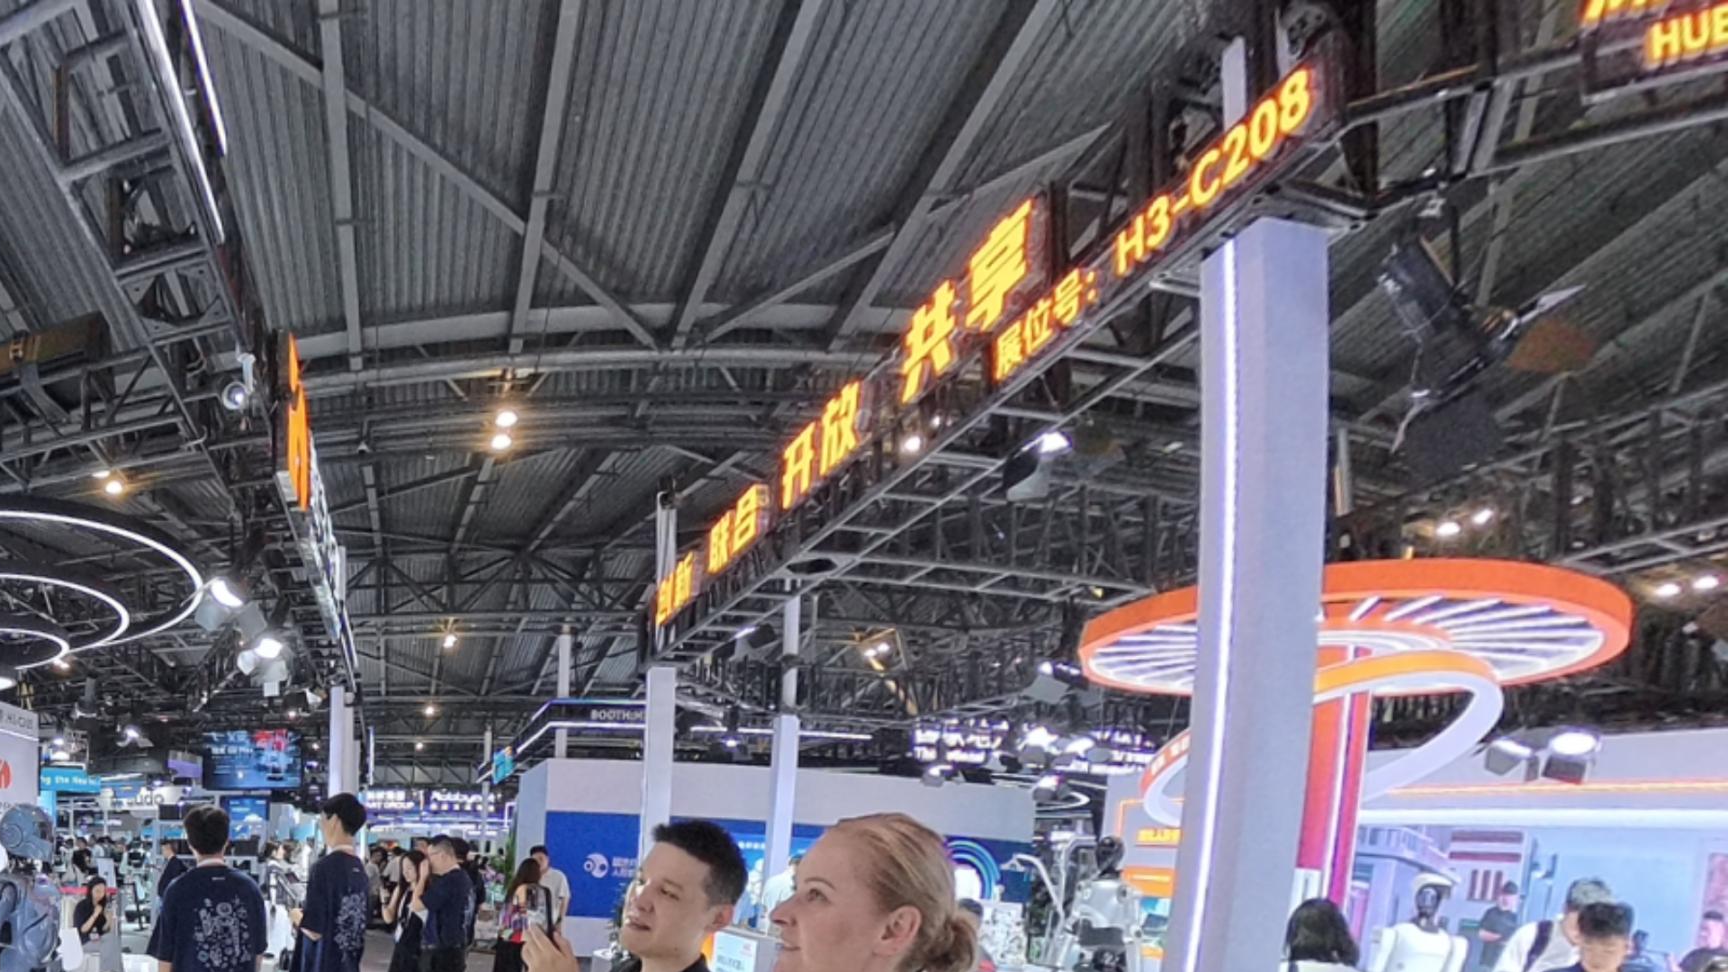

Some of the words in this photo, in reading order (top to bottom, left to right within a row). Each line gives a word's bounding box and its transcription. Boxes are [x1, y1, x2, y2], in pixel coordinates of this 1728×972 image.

[1114, 67, 1313, 277] H3-C208
[781, 380, 861, 511] 开放
[901, 198, 1034, 404] 共享
